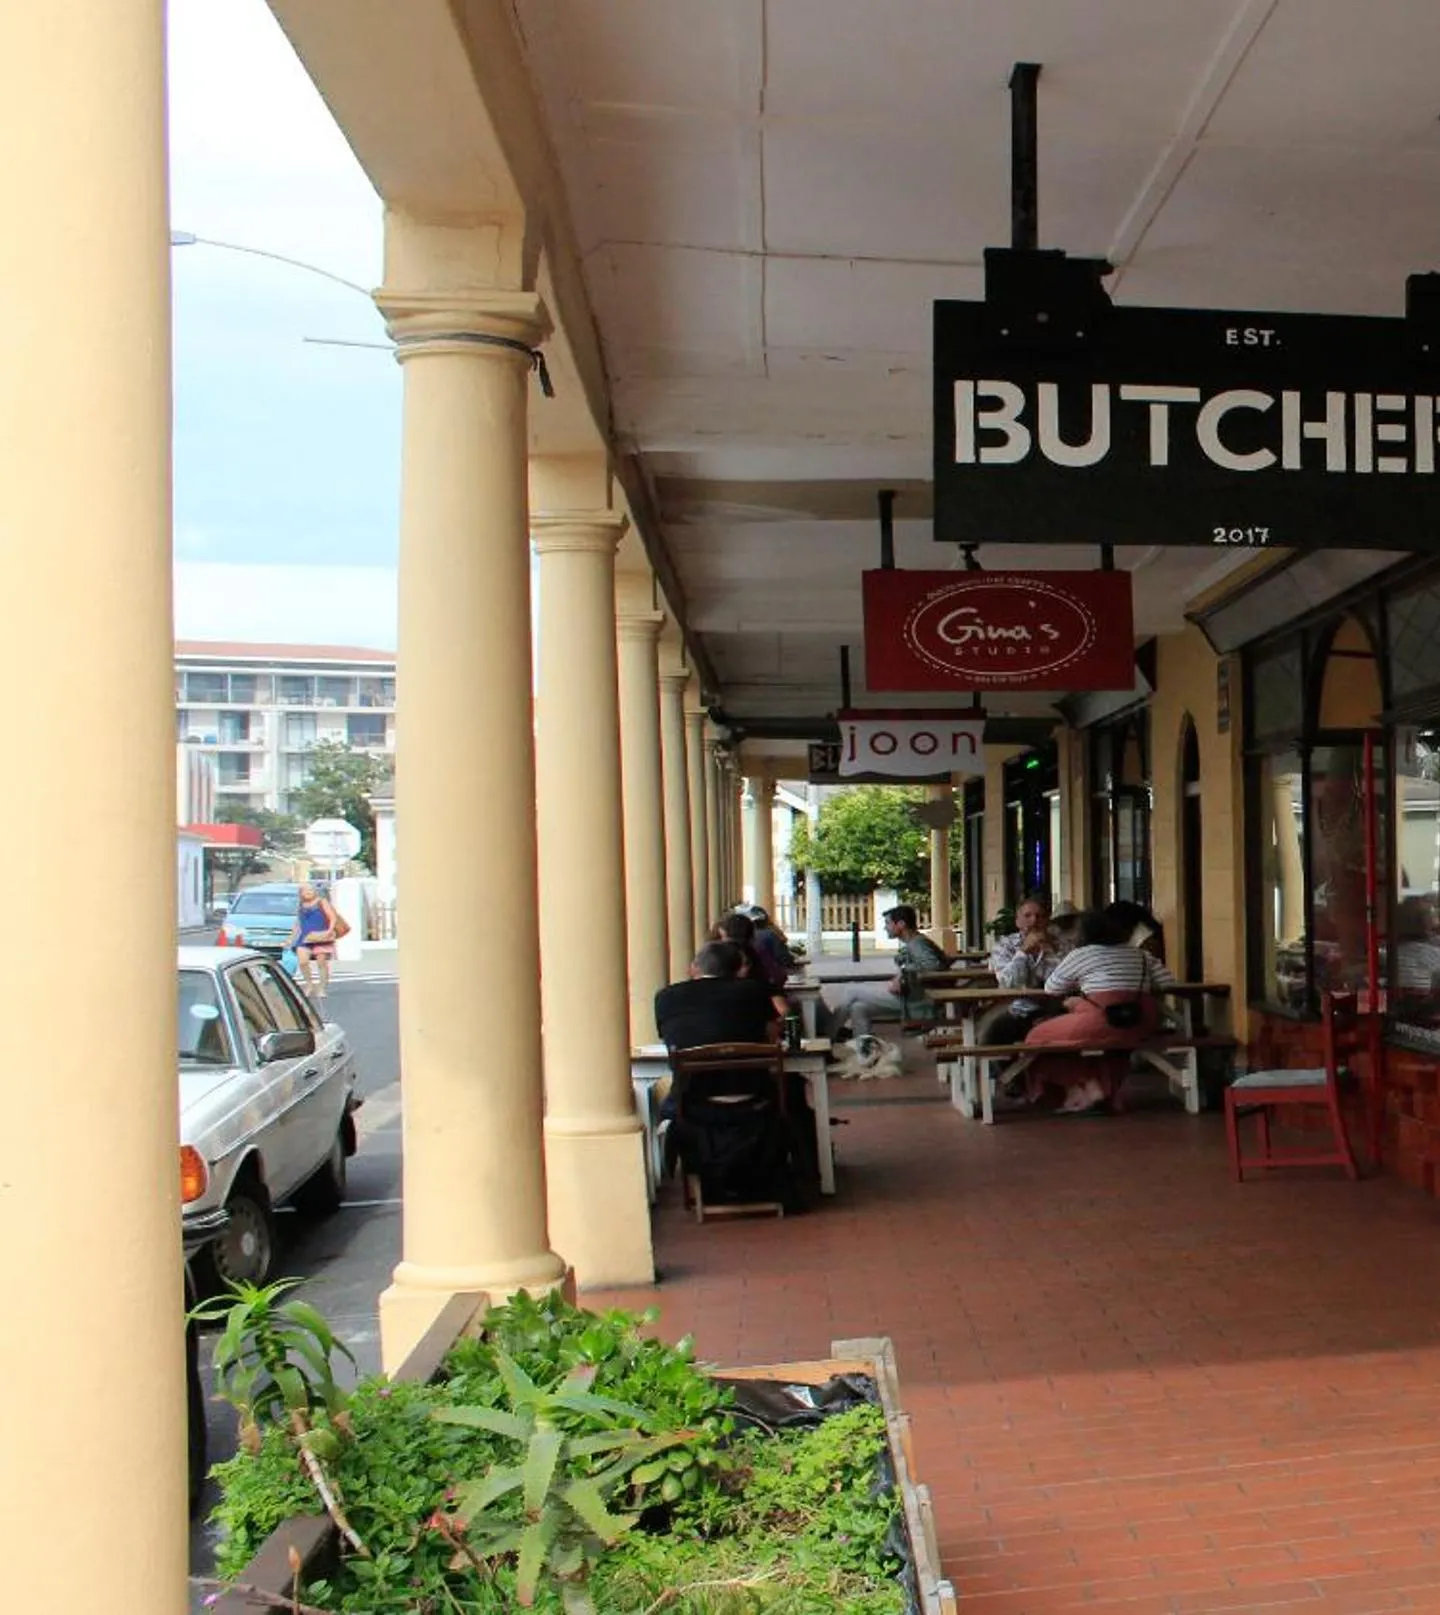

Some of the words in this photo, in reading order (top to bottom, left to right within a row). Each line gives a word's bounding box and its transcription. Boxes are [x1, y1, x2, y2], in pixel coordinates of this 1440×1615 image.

[1225, 327, 1281, 347] EST.
[1212, 527, 1269, 545] 2017
[937, 600, 1060, 644] Gina's
[848, 725, 976, 761] joon
